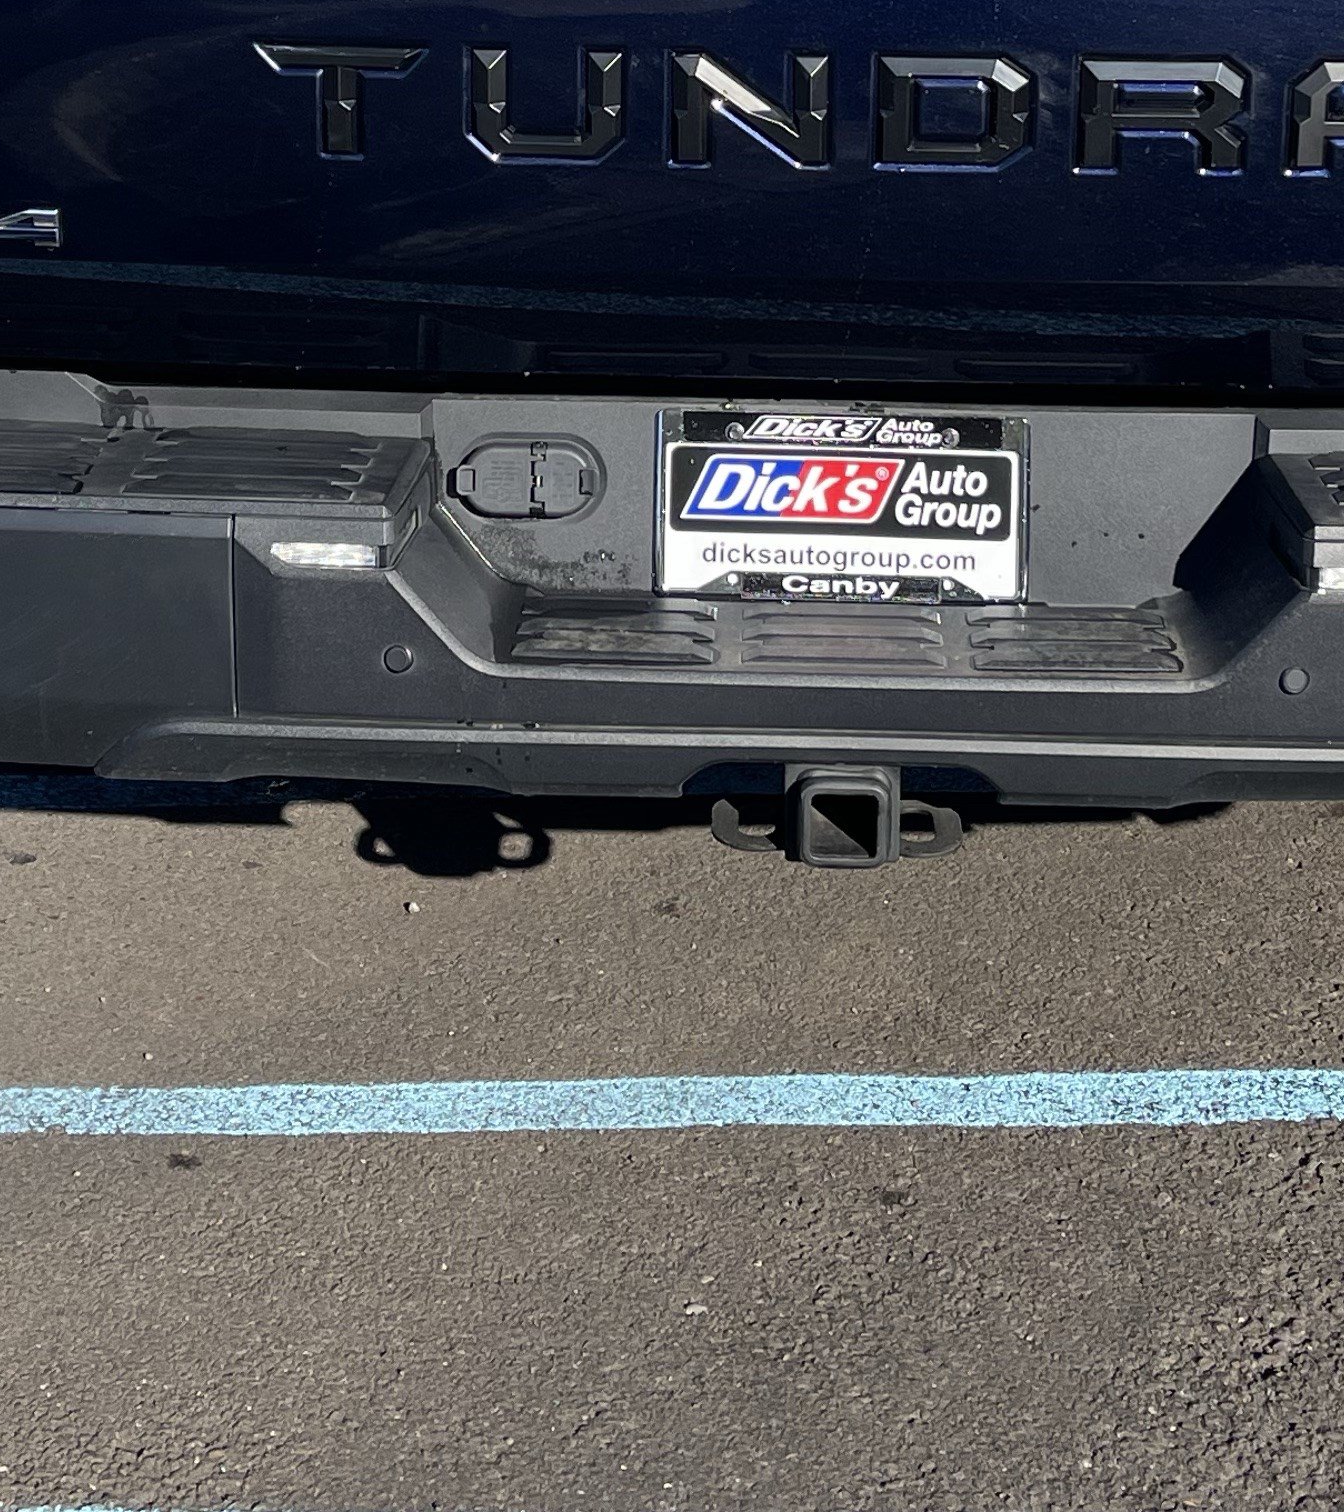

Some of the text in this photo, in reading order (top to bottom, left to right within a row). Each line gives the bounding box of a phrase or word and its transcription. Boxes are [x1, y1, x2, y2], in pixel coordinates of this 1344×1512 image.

[759, 418, 866, 438] Dick's
[876, 430, 943, 445] Group
[880, 419, 934, 432] Auto
[697, 462, 878, 513] Dick's
[901, 462, 988, 497] Auto
[894, 494, 1002, 535] Group
[702, 542, 976, 573] dicksautogroup.com
[781, 575, 900, 600] Canby
